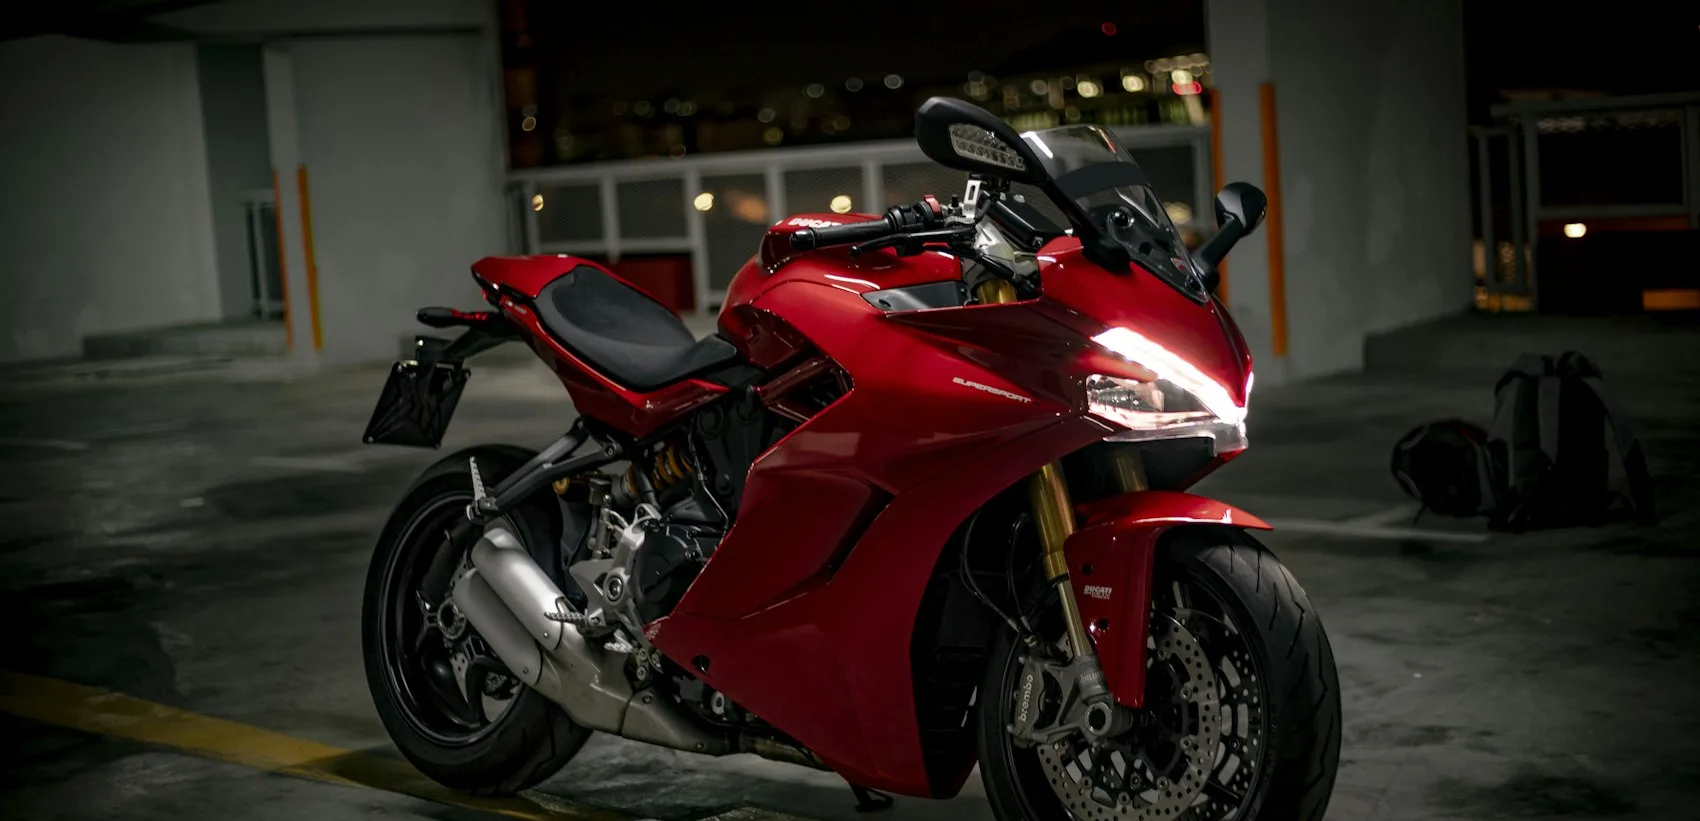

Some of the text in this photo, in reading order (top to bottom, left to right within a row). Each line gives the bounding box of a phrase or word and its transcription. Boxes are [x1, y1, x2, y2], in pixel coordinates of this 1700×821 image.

[787, 218, 842, 228] DUCA
[952, 377, 1031, 403] SUPERSPORT
[1083, 585, 1112, 596] DUCATI
[1018, 674, 1034, 722] brembo
